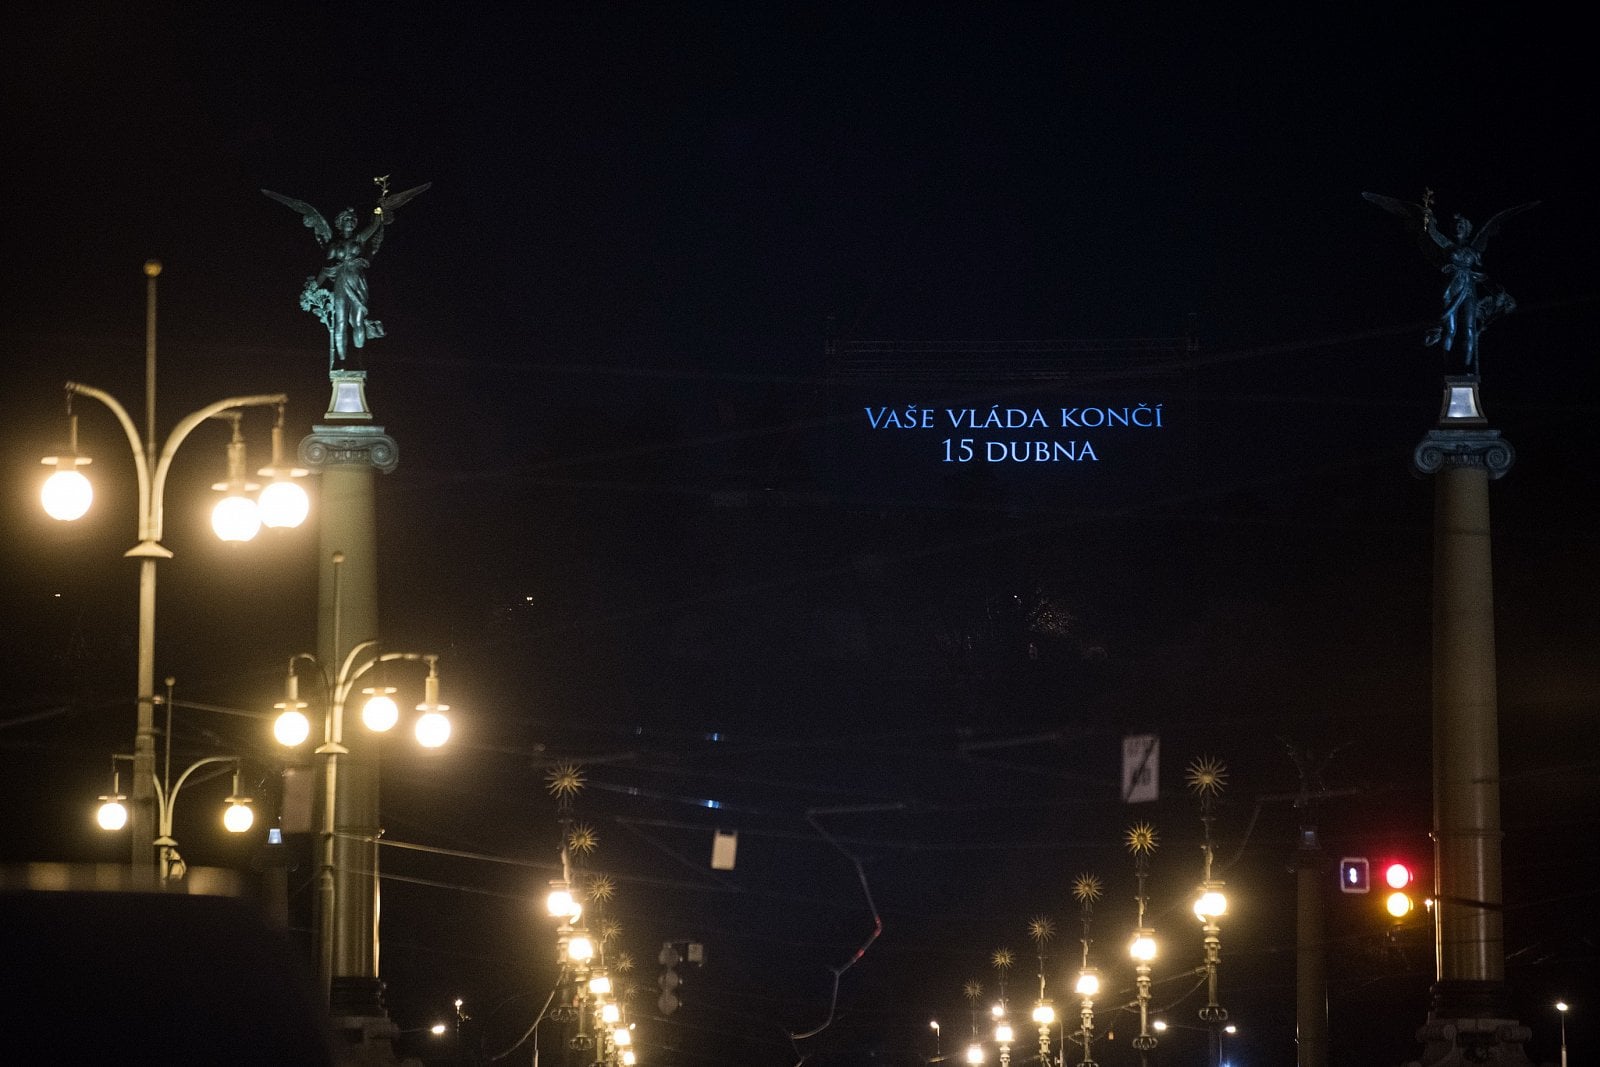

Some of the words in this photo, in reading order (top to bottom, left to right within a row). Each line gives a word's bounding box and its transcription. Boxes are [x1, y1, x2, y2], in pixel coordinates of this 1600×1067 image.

[864, 405, 934, 428] VAŠE
[945, 404, 1050, 428] VLÁDA
[1060, 403, 1164, 428] KONČÍ
[942, 438, 974, 462] 15
[985, 440, 1099, 463] DUBNA
